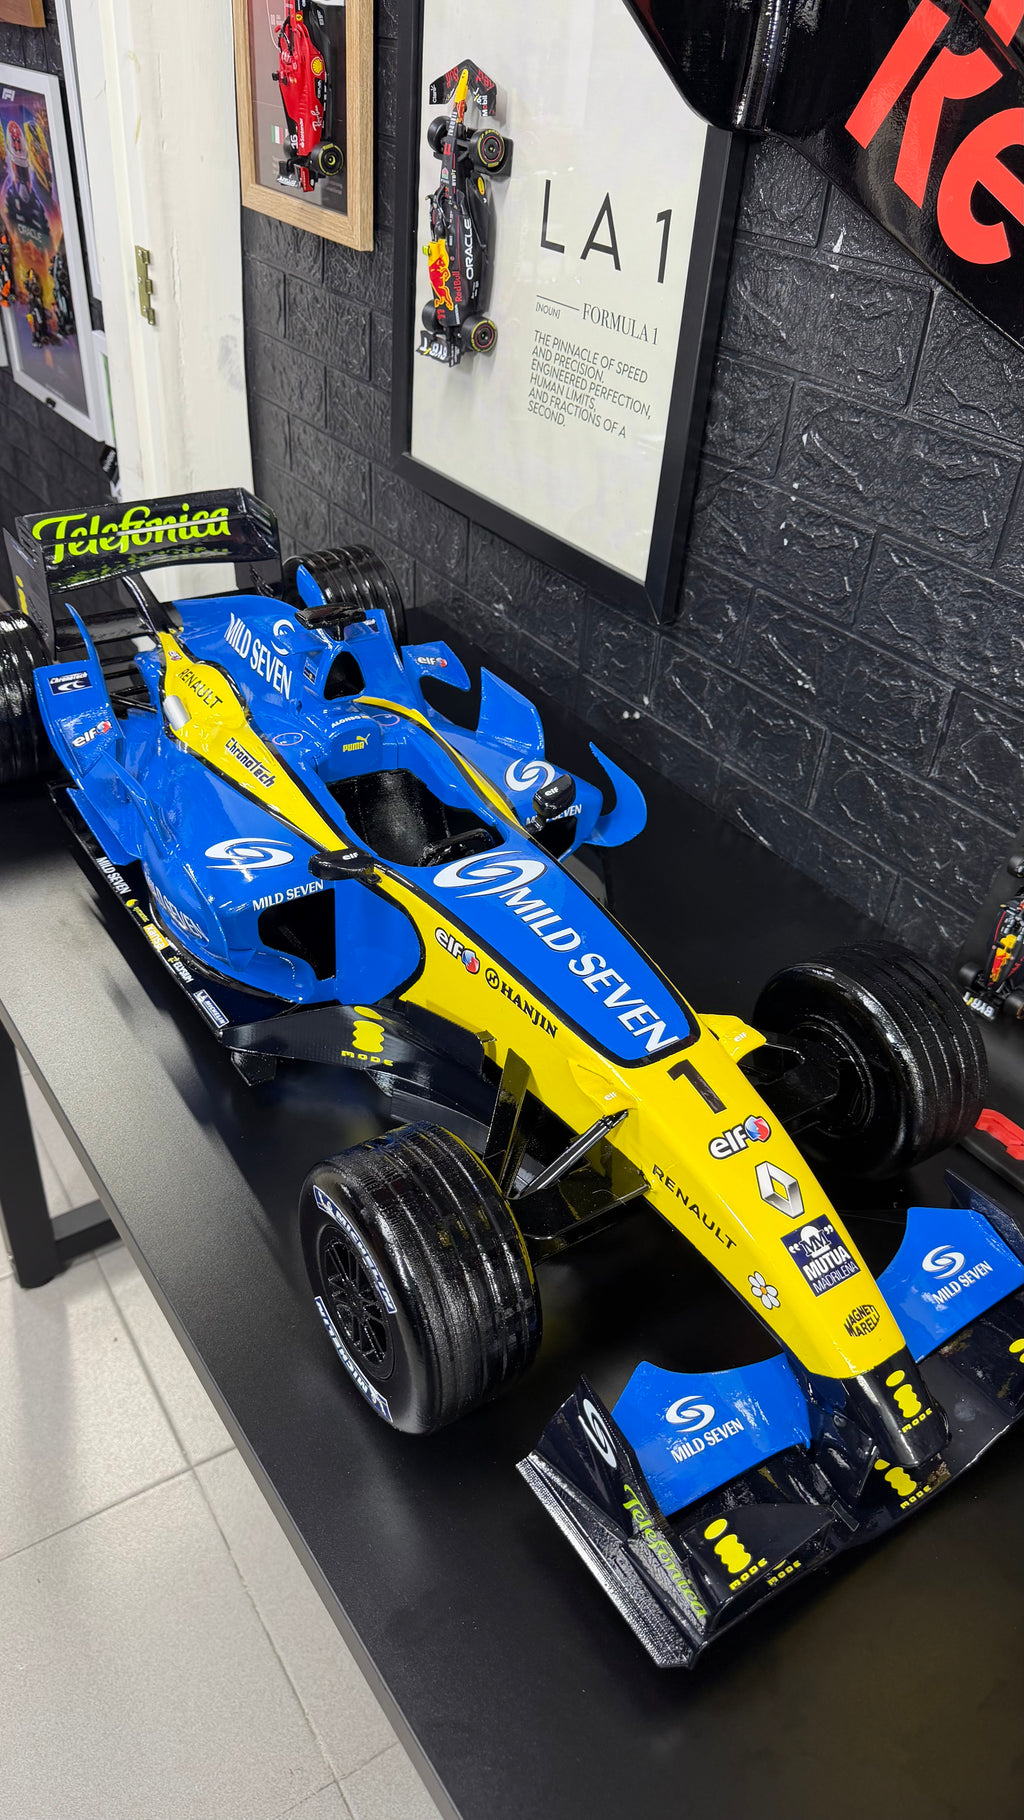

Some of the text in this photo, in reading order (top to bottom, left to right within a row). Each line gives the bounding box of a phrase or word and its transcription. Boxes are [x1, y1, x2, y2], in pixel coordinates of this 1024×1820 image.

[291, 134, 298, 150] 16
[18, 224, 43, 244] ORACLE
[463, 217, 474, 280] ORACLE
[655, 208, 673, 284] 1
[452, 270, 462, 302] Red Bull
[582, 302, 658, 346] FORMULA 1
[531, 345, 605, 384] AND PRECISION.
[534, 329, 648, 384] THE PINNACLE OF SPEED
[530, 372, 565, 396] HUMAN
[531, 358, 651, 420] ENGINEERED PERFECTION,
[527, 400, 566, 427] SECOND.
[528, 386, 626, 438] AND FRACTIONS OF A
[224, 612, 252, 659] MILD
[250, 638, 293, 700] SEVEN
[416, 655, 437, 666] elf
[177, 668, 223, 709] RENAULT
[72, 728, 98, 748] elf
[331, 715, 361, 728] ALONSO
[342, 741, 365, 753] PUMA
[544, 786, 560, 796] elf
[342, 851, 359, 860] elf
[96, 856, 132, 895] MILD SEVEN
[252, 878, 324, 912] MILD SEVEN
[435, 927, 464, 959] elf
[499, 886, 680, 1054] MILD SEVEN
[500, 982, 558, 1039] HANJIN
[733, 1031, 747, 1043] elf
[604, 1091, 618, 1102] elf
[666, 1058, 727, 1115] 1
[708, 1124, 752, 1160] elf
[652, 1164, 737, 1250] RENAULT
[802, 1245, 851, 1281] MUTUA
[932, 1260, 994, 1305] MILD SEVEN
[670, 1417, 745, 1463] MILD SEVEN
